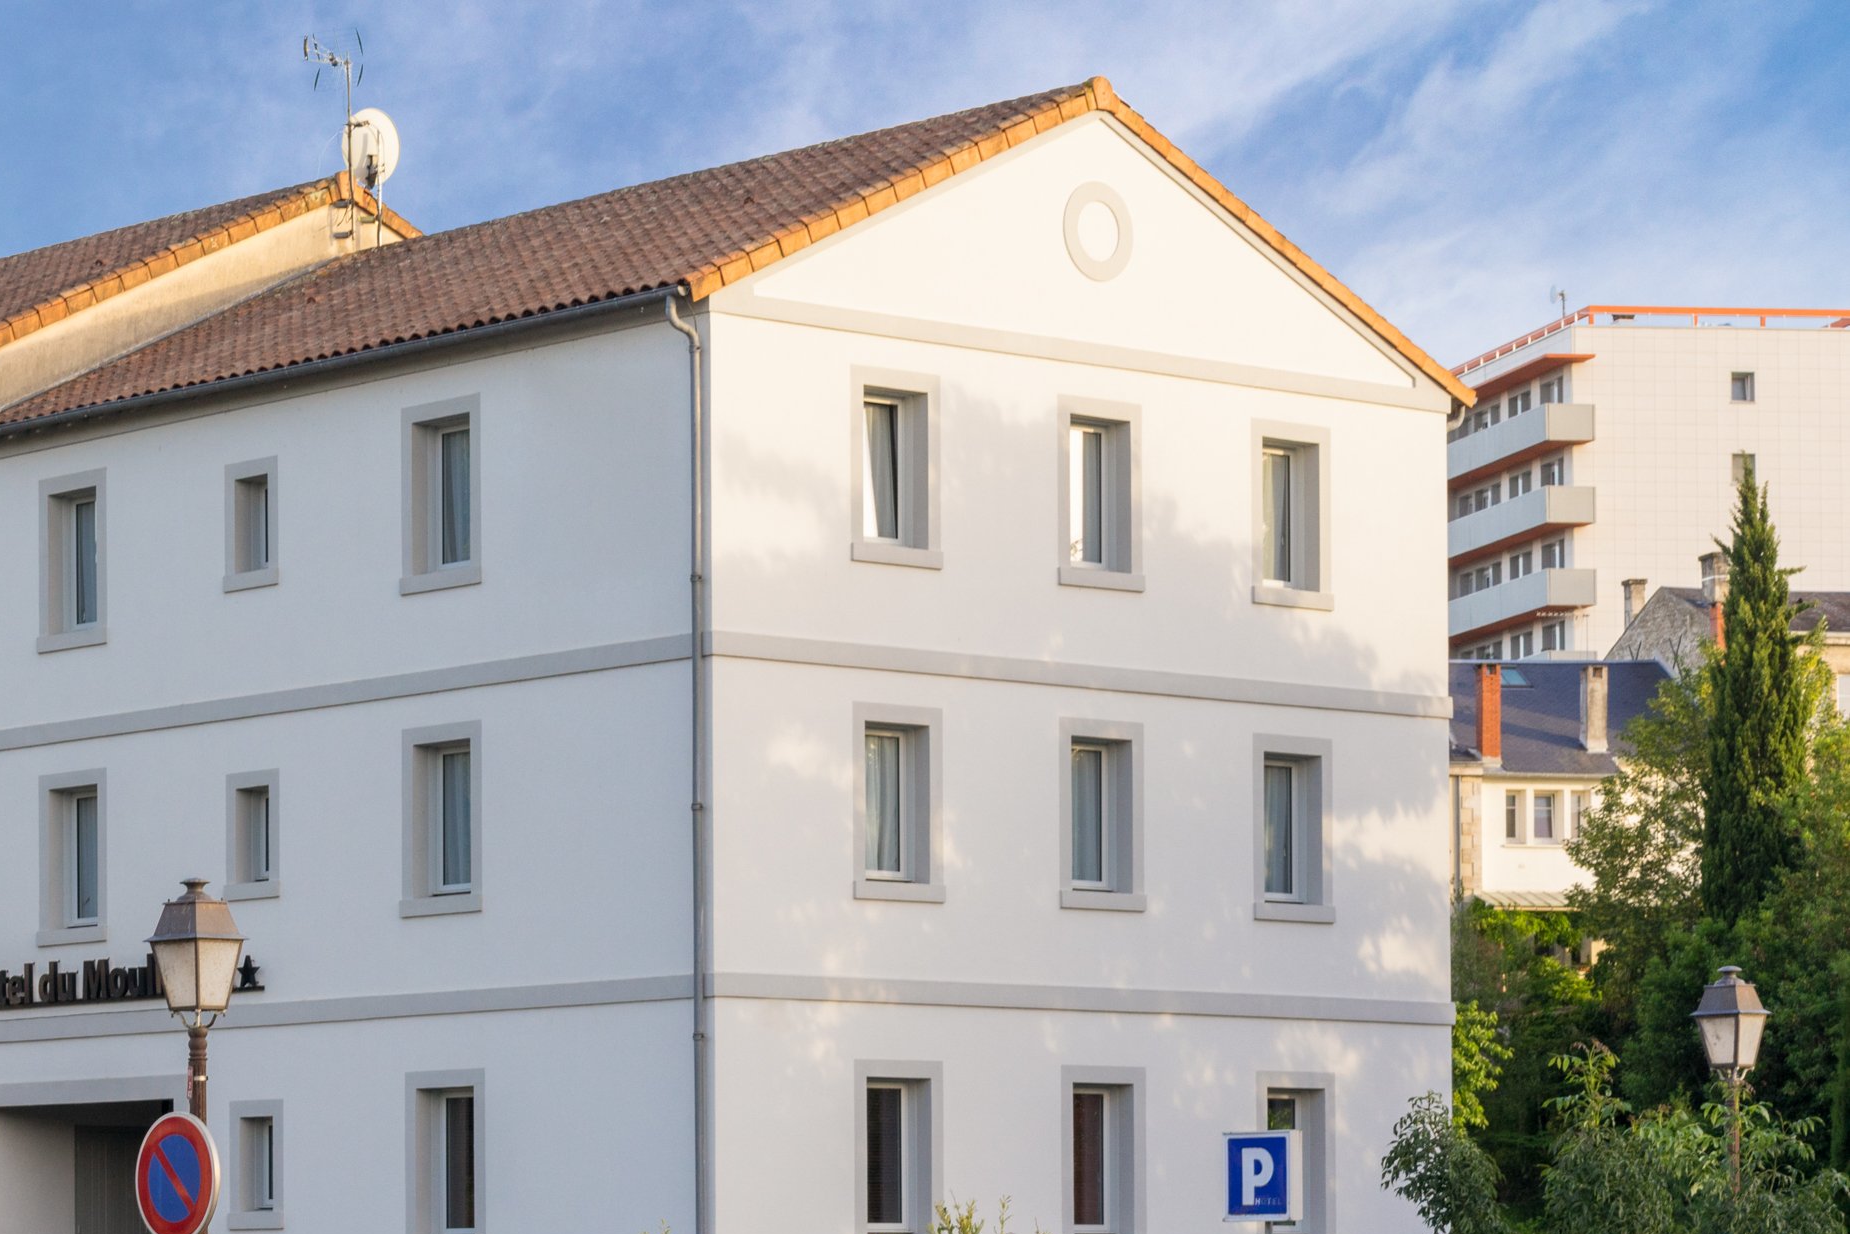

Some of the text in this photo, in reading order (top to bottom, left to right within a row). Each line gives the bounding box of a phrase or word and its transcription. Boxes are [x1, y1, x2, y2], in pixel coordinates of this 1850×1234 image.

[38, 960, 78, 1003] du
[82, 953, 165, 1000] Moul
[1242, 1147, 1274, 1206] P
